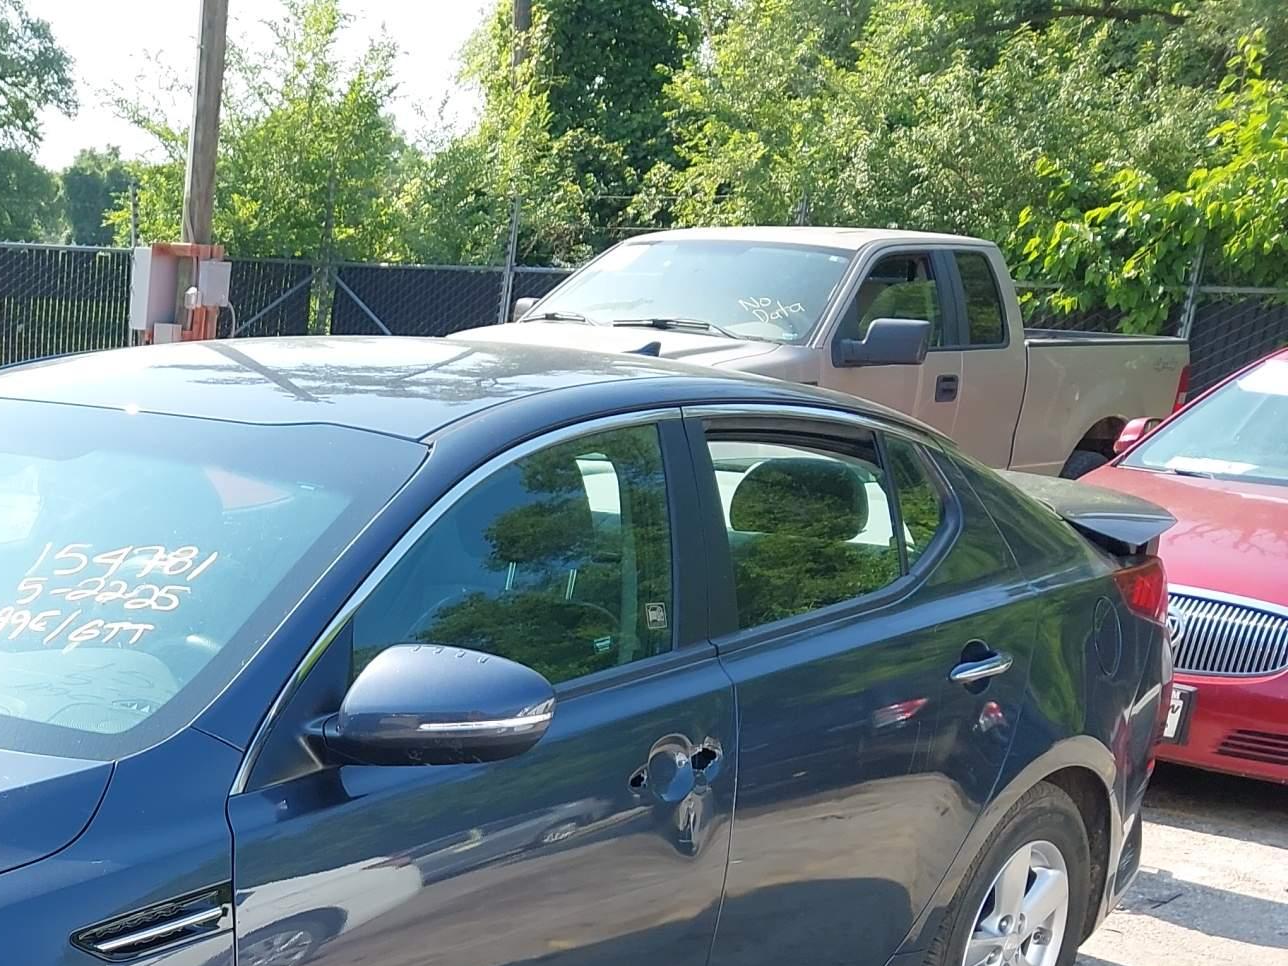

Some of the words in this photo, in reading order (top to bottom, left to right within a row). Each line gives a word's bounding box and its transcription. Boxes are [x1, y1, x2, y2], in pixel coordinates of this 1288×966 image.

[738, 296, 772, 312] No
[752, 300, 806, 324] Data
[25, 542, 219, 582] 154781
